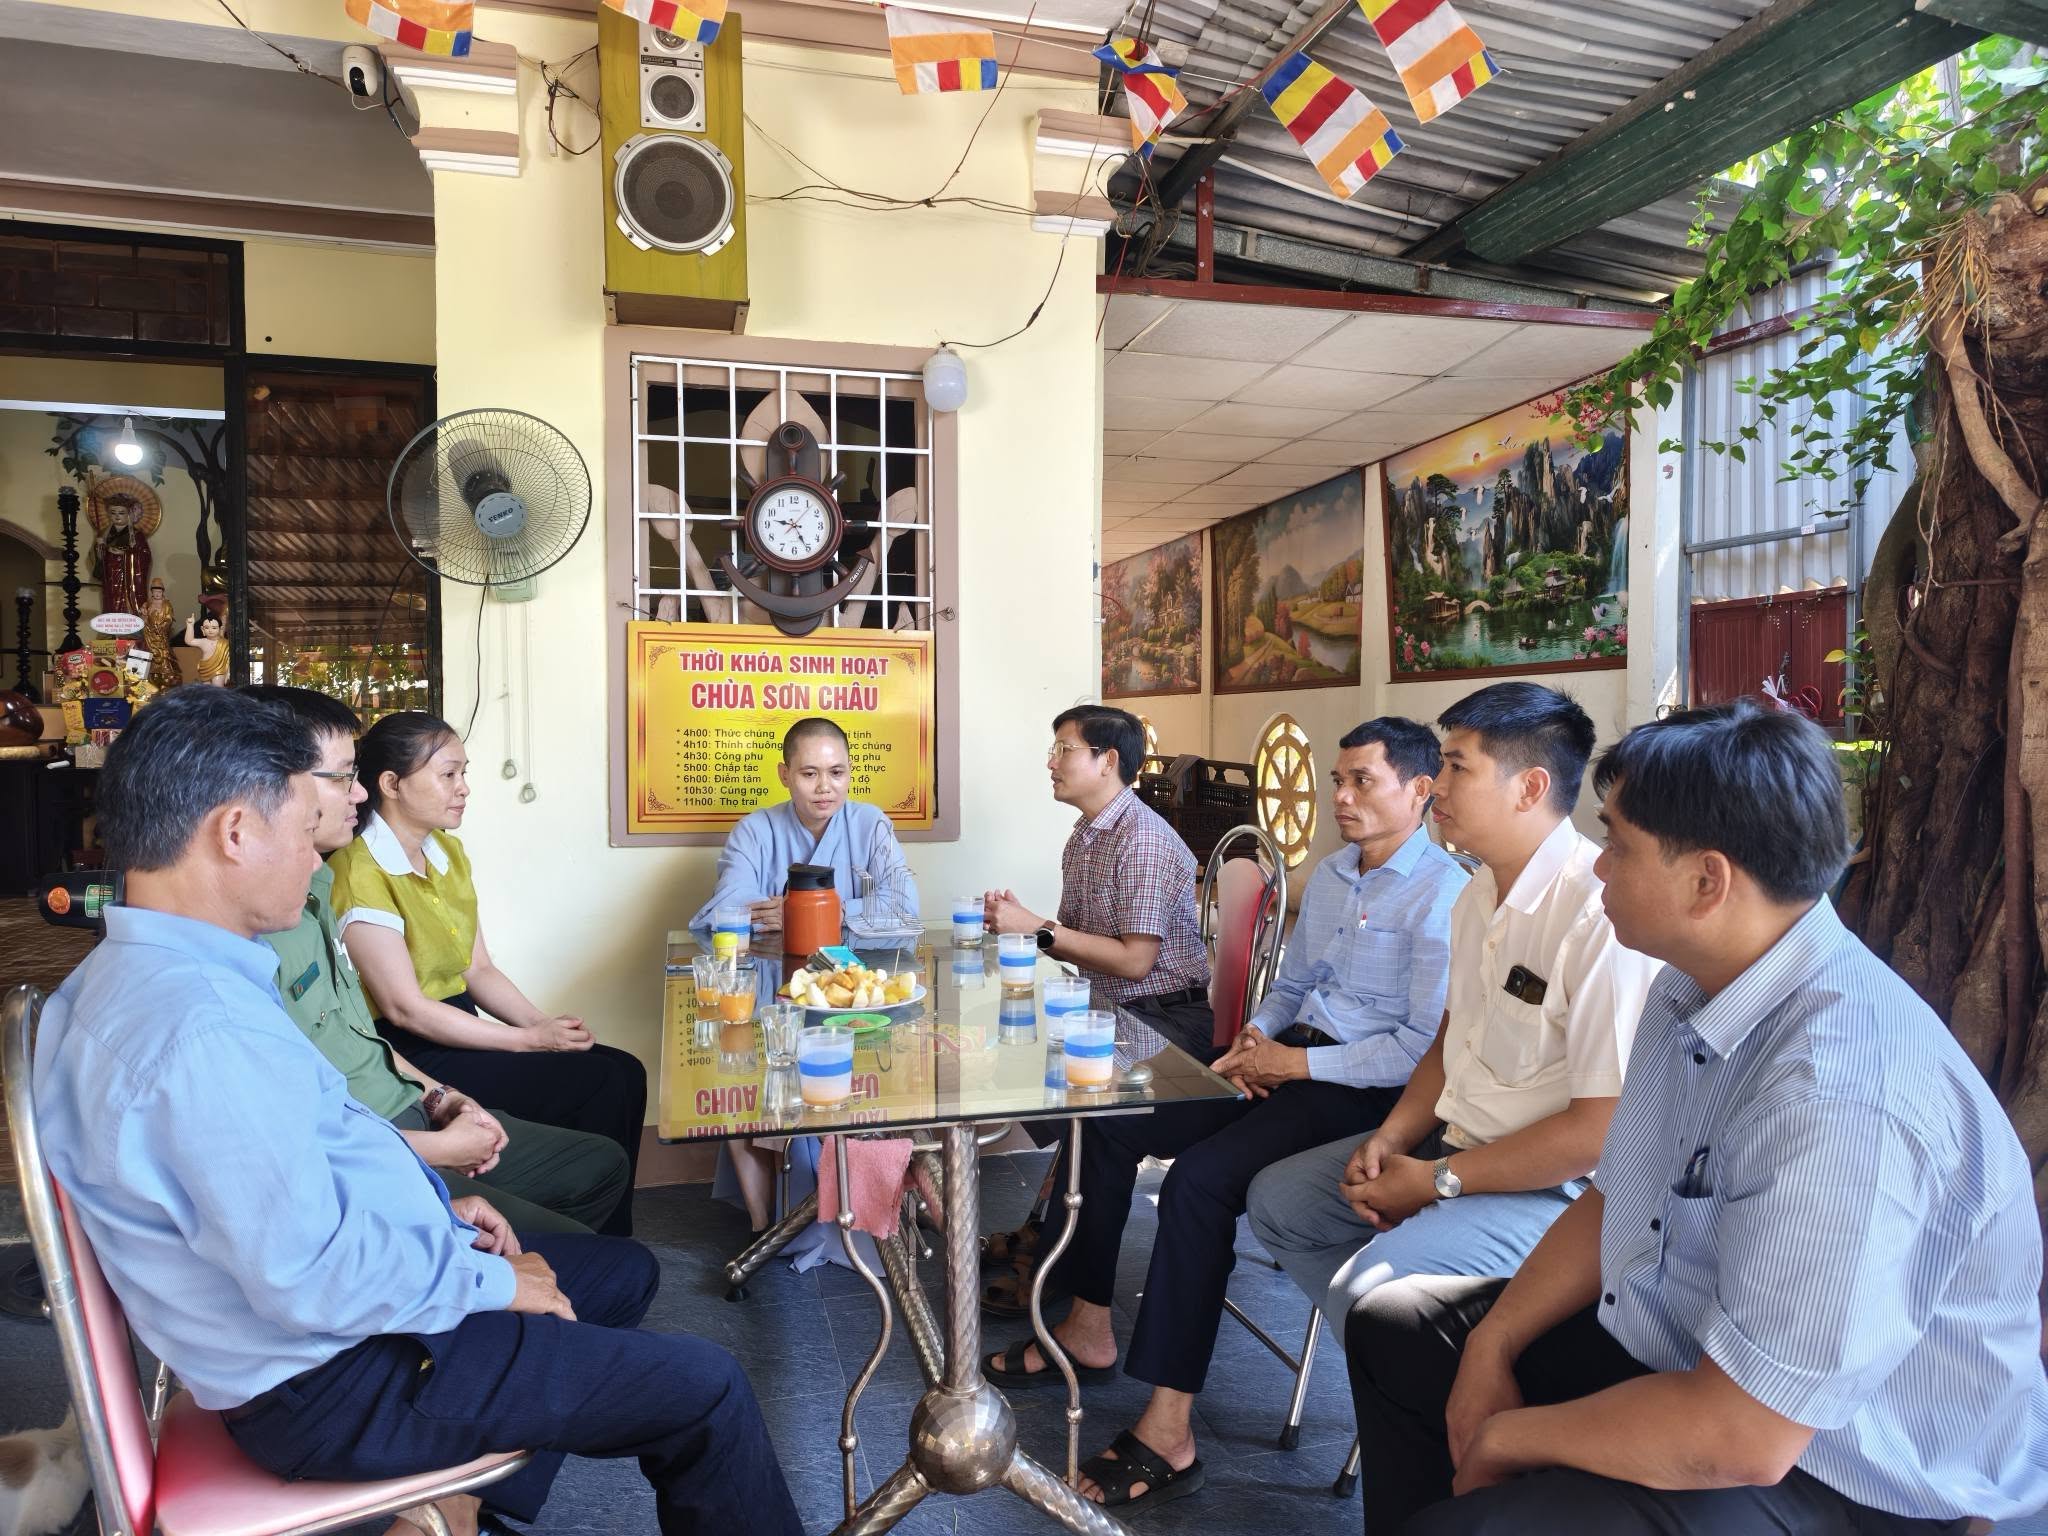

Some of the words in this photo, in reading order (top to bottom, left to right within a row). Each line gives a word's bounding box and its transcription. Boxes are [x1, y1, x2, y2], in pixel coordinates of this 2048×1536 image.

[778, 498, 784, 507] 11
[790, 496, 799, 504] 12
[806, 500, 809, 508] 1
[768, 508, 776, 517] 10
[814, 508, 820, 518] 2
[764, 520, 770, 529] 9
[818, 522, 824, 530] 3
[769, 533, 774, 542] 8
[815, 534, 820, 542] 4
[780, 543, 785, 552] 7
[791, 546, 797, 555] 6
[806, 544, 811, 552] 5
[680, 649, 724, 671] THỜI
[731, 652, 783, 672] KHÓA
[790, 656, 834, 674] SINH
[842, 658, 888, 678] HOẠT
[692, 678, 755, 708] CHÙA
[763, 683, 810, 710] SƠN
[818, 682, 878, 710] CHÂU
[684, 729, 711, 737] 4h00:
[684, 740, 711, 748] 4h10:
[746, 741, 783, 751] chuông
[862, 741, 892, 752] chúng
[684, 752, 711, 760] 4h30:
[715, 752, 740, 761] Công
[745, 752, 763, 762] phu
[862, 753, 880, 762] phu
[684, 775, 711, 783] 6h00:
[684, 786, 716, 794] 10h30:
[684, 798, 716, 806] 11h00:
[720, 798, 738, 807] Thọ
[742, 798, 758, 806] trai
